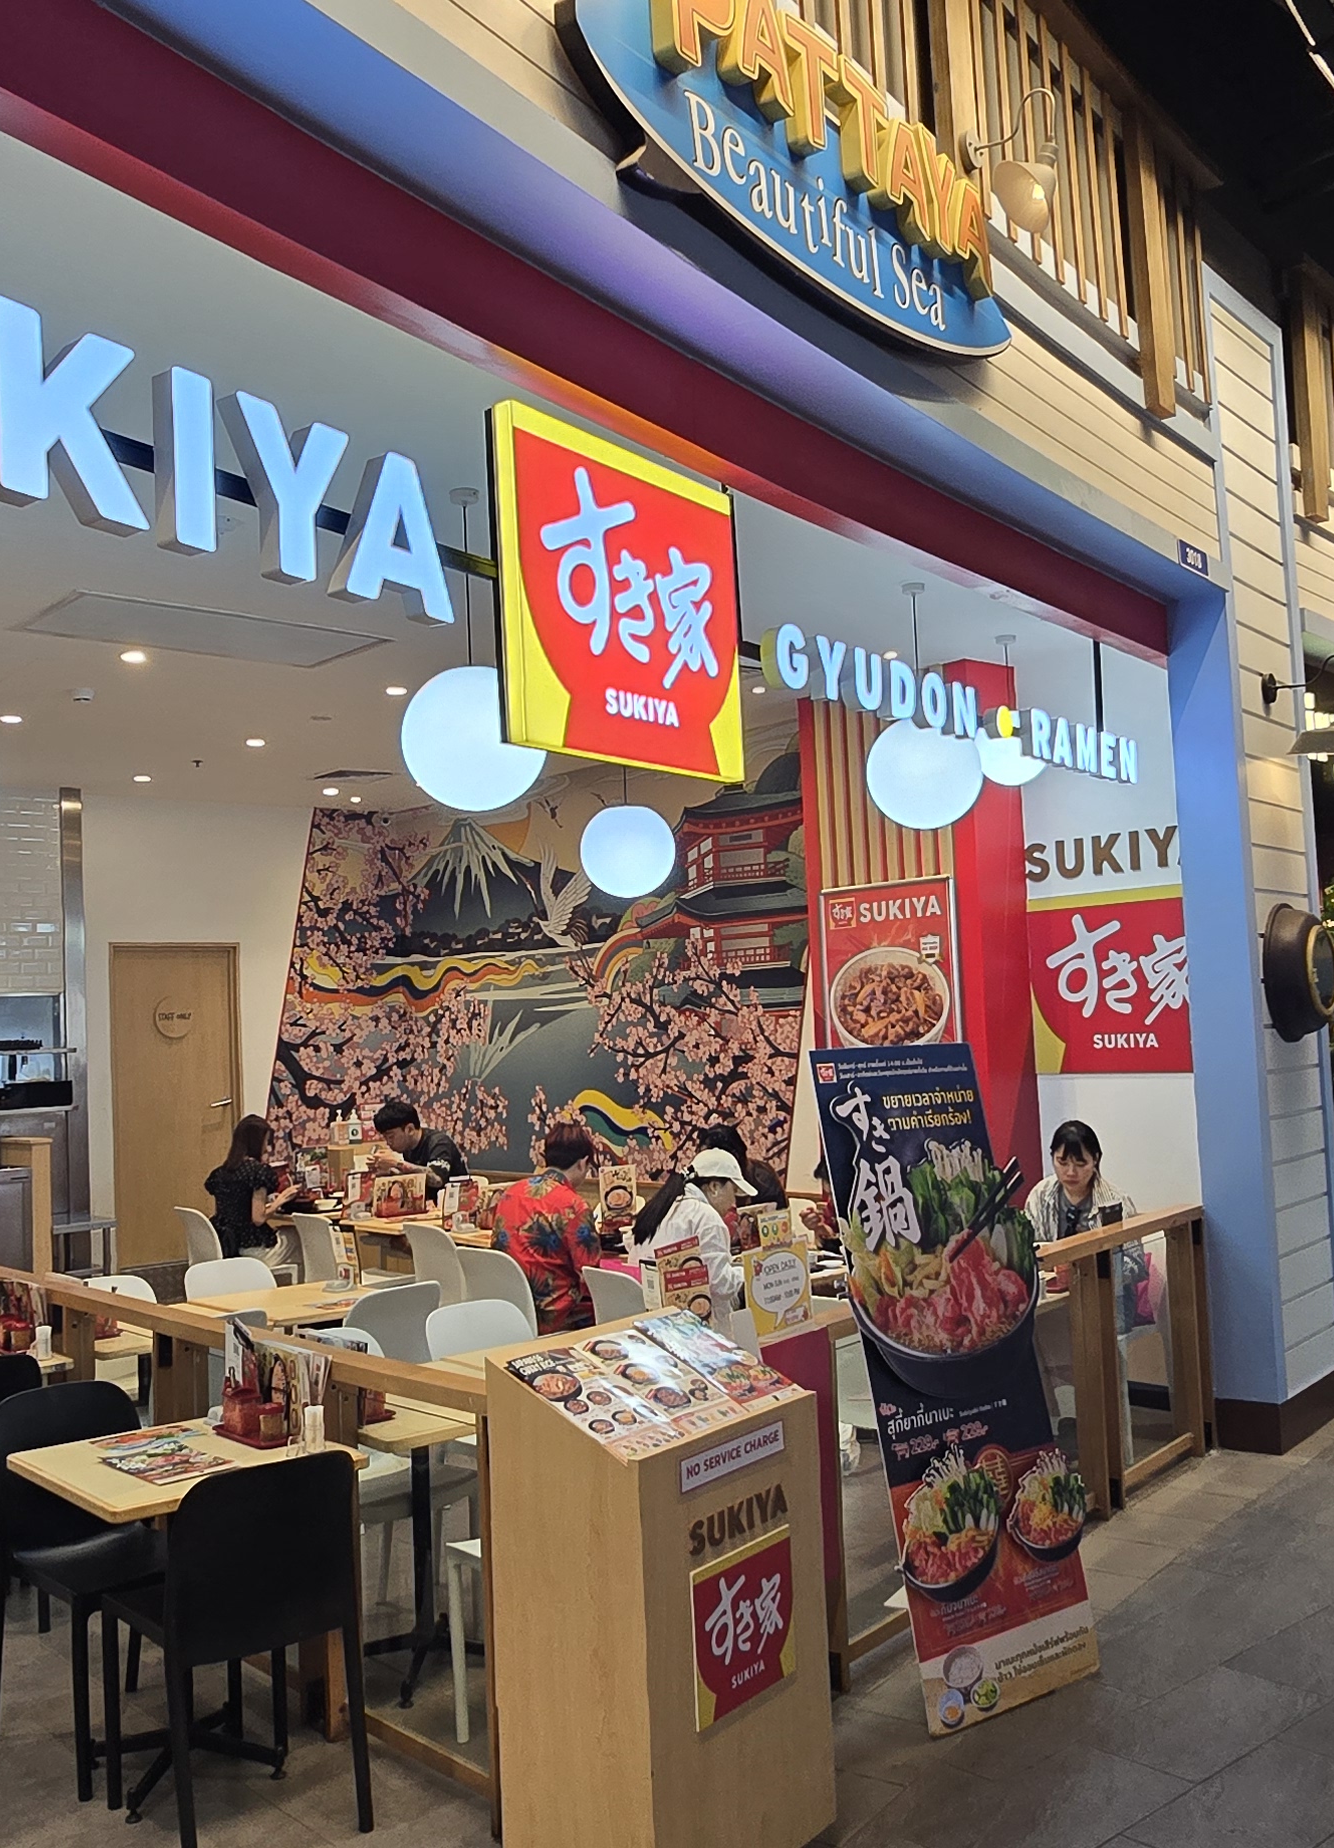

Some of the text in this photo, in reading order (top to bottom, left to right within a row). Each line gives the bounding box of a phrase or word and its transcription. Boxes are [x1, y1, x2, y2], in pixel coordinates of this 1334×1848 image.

[659, 0, 994, 300] PATTAYA
[683, 88, 947, 332] Beautiful Sea
[539, 465, 720, 690] すき家
[604, 686, 681, 728] SUKIYA
[773, 622, 1139, 785] GYUDON RAMEN
[1024, 824, 1181, 883] SUKIY
[859, 895, 942, 924] SUKIYA
[1045, 913, 1191, 1026] すき家
[1092, 1032, 1159, 1050] SUKIYA
[686, 1429, 780, 1480] NO SERVICE CHARGE
[688, 1483, 789, 1557] SUKIYA
[704, 1572, 784, 1666] すき家
[730, 1659, 766, 1690] SUKIYA
